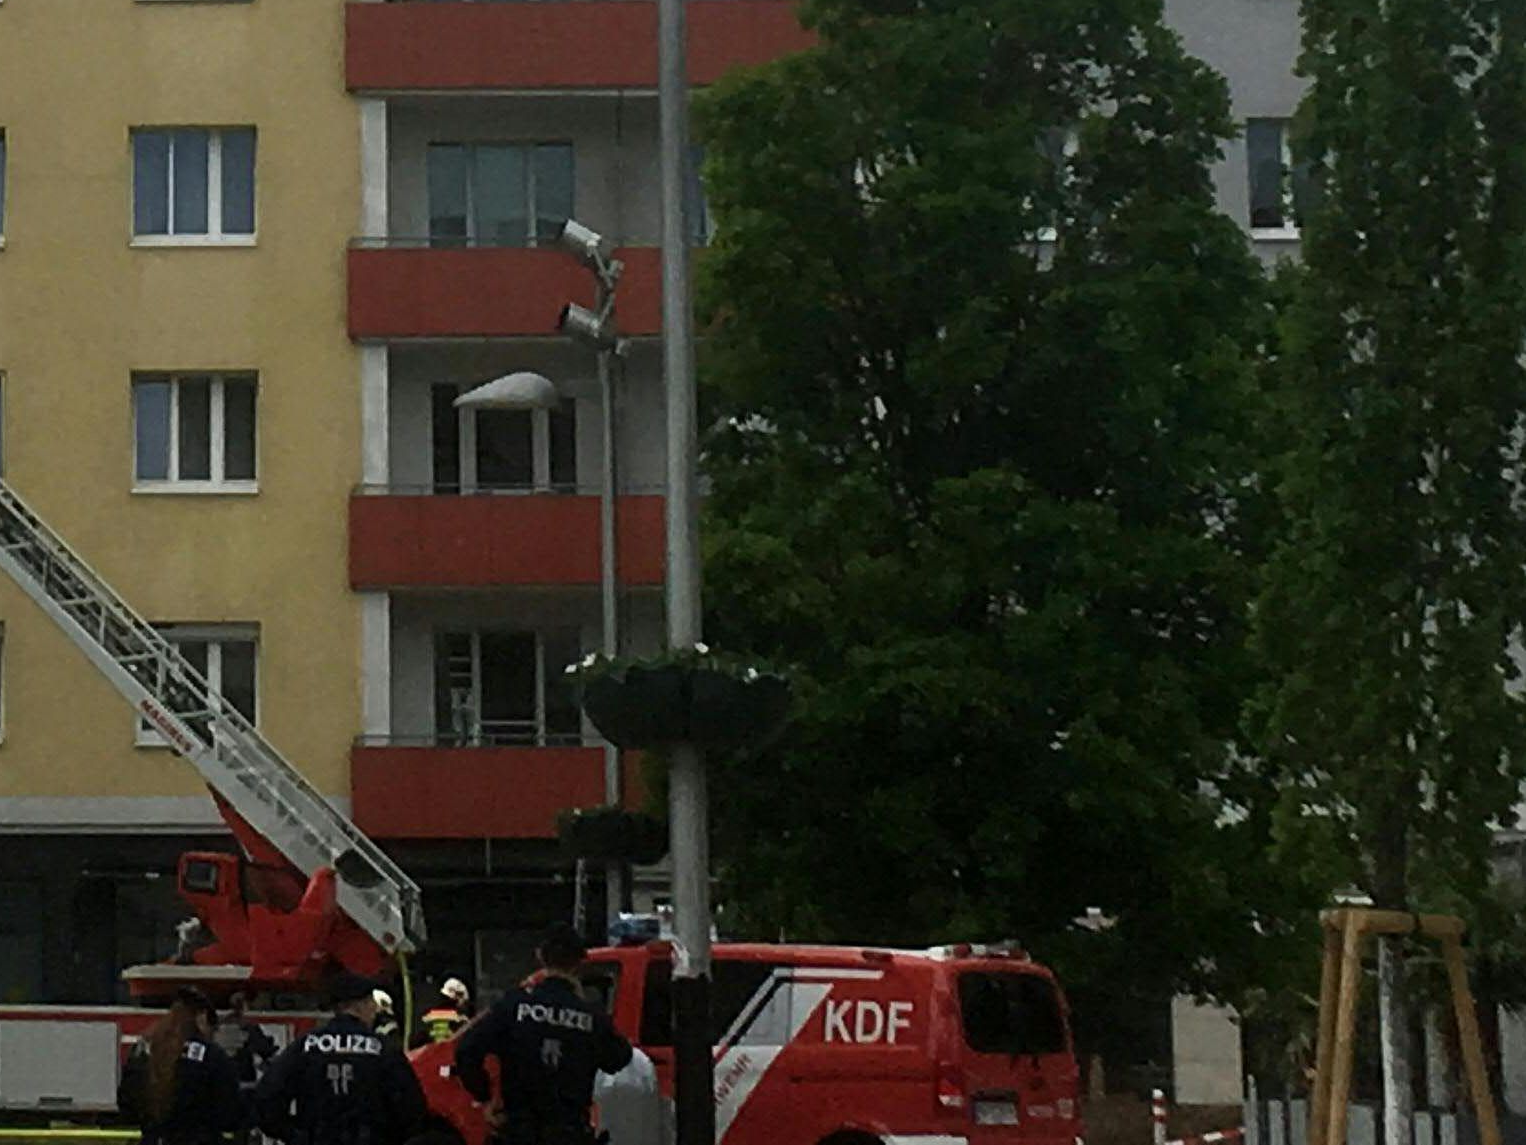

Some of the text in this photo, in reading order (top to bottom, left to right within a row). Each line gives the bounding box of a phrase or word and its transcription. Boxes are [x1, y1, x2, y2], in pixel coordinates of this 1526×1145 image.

[517, 1002, 594, 1032] POLIZEI
[823, 999, 914, 1044] KDF
[304, 1033, 383, 1055] POLIZEI
